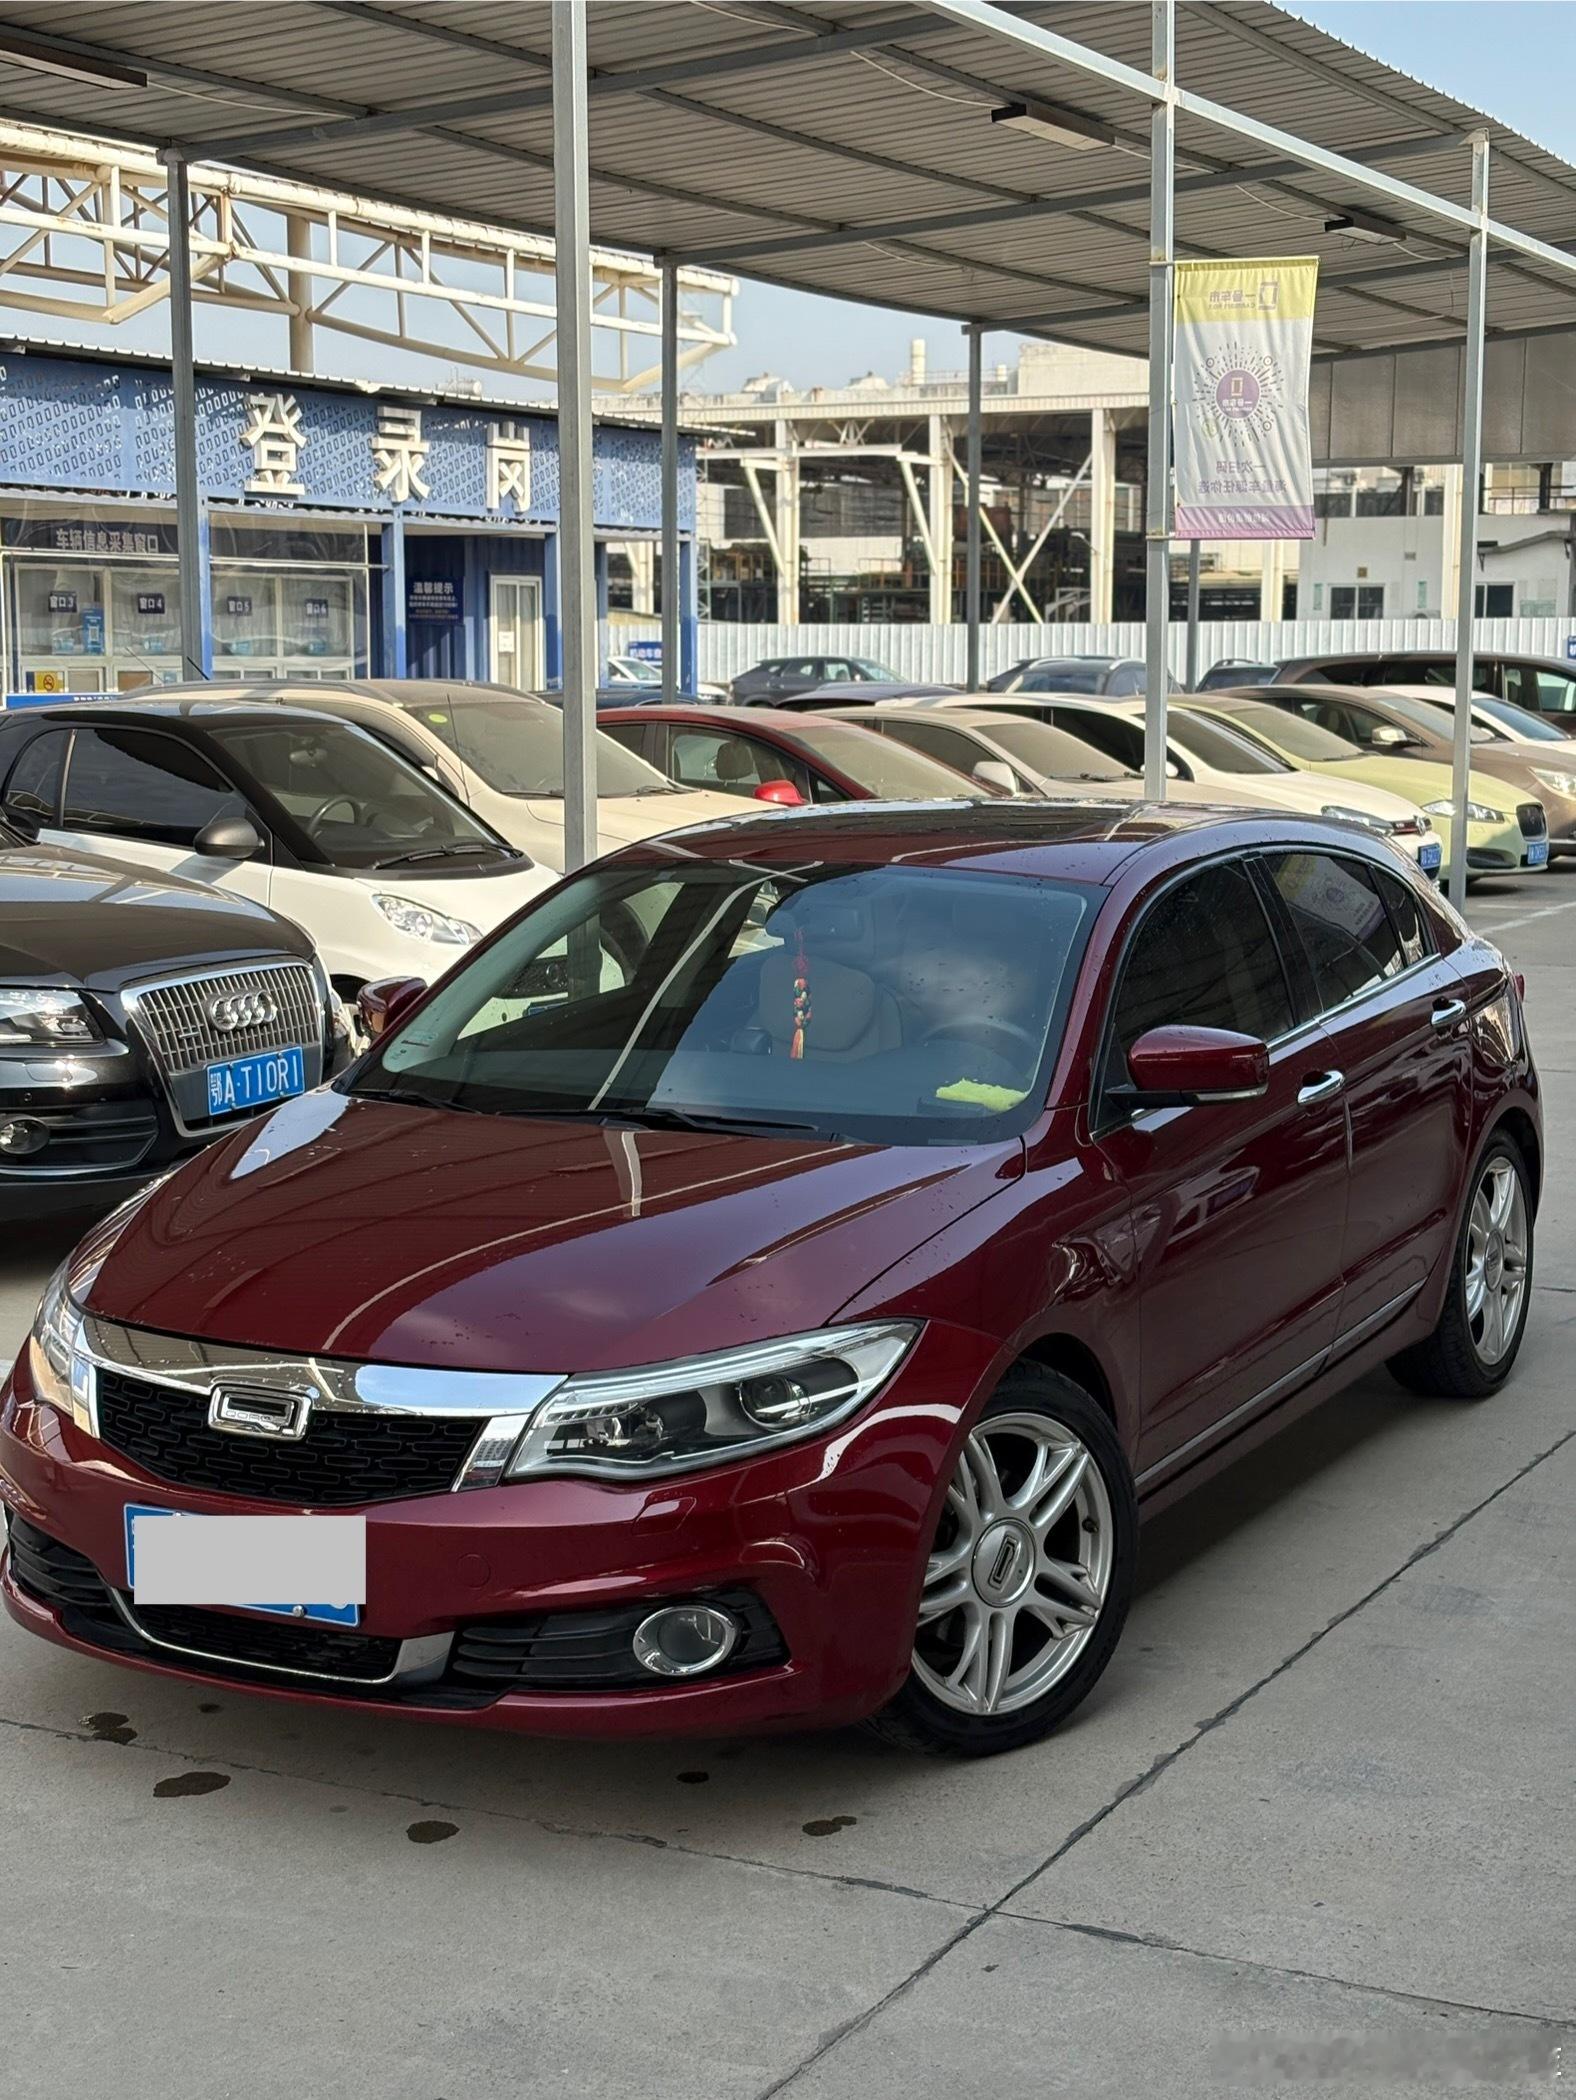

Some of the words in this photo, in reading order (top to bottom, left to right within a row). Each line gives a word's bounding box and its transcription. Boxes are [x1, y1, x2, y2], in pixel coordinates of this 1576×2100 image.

[240, 392, 531, 514] 登录岗
[56, 528, 159, 554] 车辆信息采集窗口
[413, 581, 454, 595] 温馨提示
